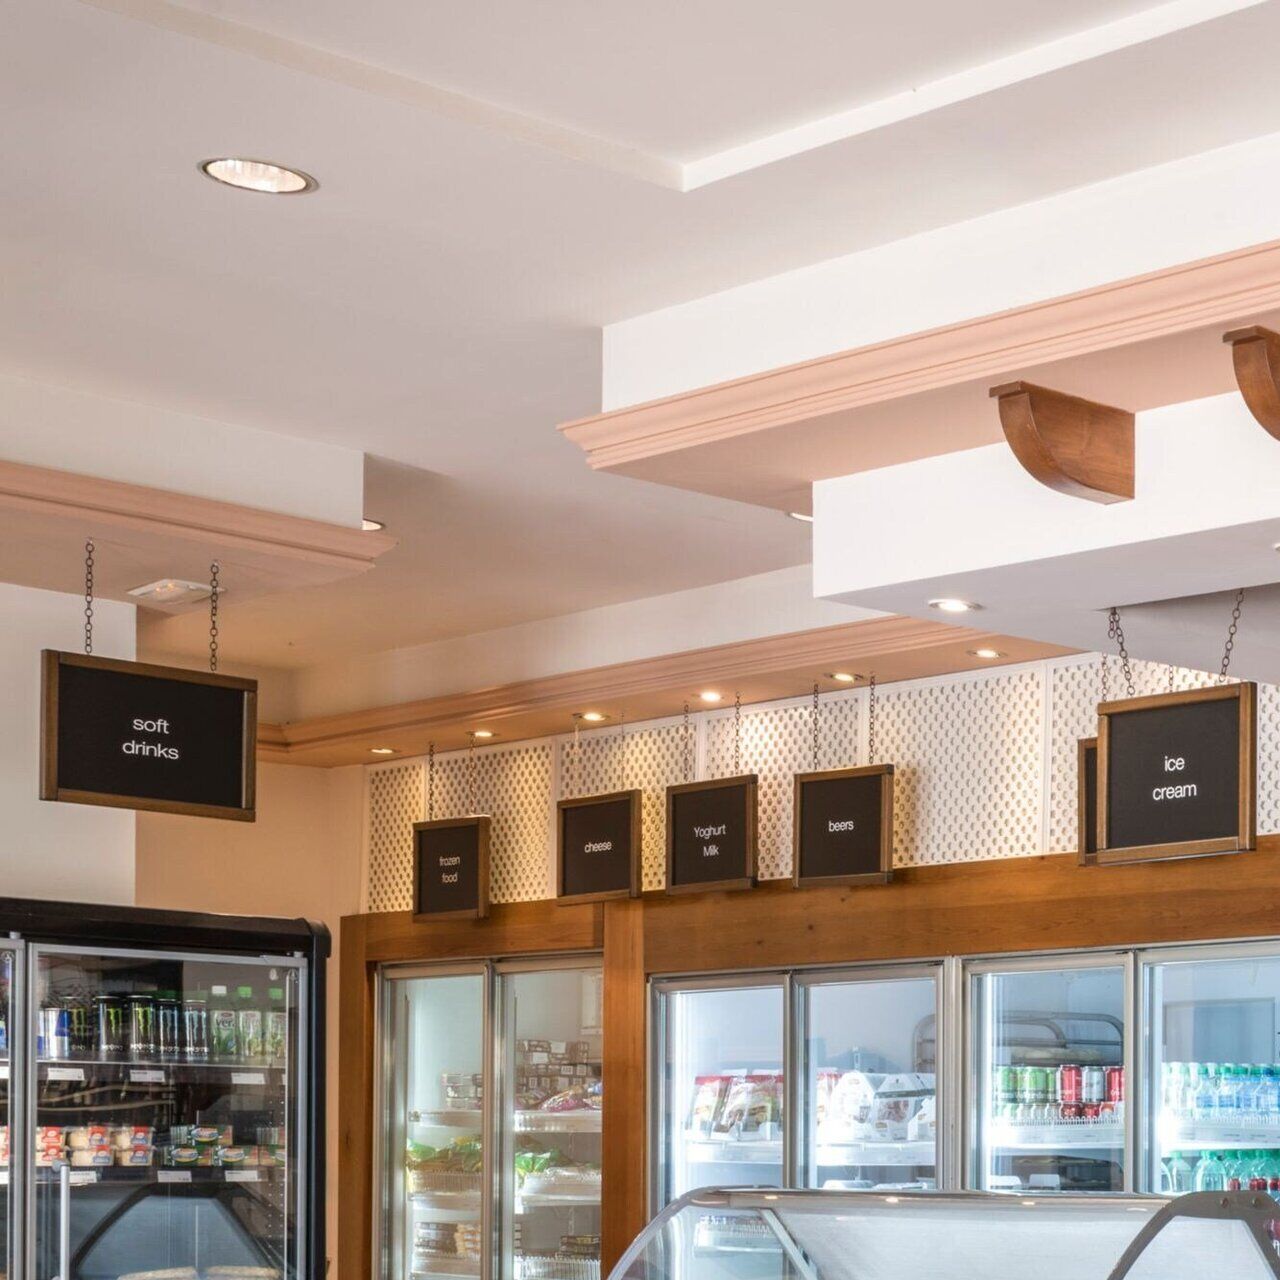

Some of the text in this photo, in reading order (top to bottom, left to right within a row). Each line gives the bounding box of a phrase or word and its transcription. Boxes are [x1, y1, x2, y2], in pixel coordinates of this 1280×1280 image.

[132, 718, 170, 734] soft
[122, 740, 180, 761] drinks
[1164, 755, 1186, 772] ice
[1152, 783, 1198, 801] cream
[693, 824, 726, 840] Yoghurt
[828, 820, 855, 833] beers
[584, 841, 612, 854] cheese
[703, 844, 719, 857] Milk
[439, 856, 461, 867] frozen
[441, 873, 458, 883] food
